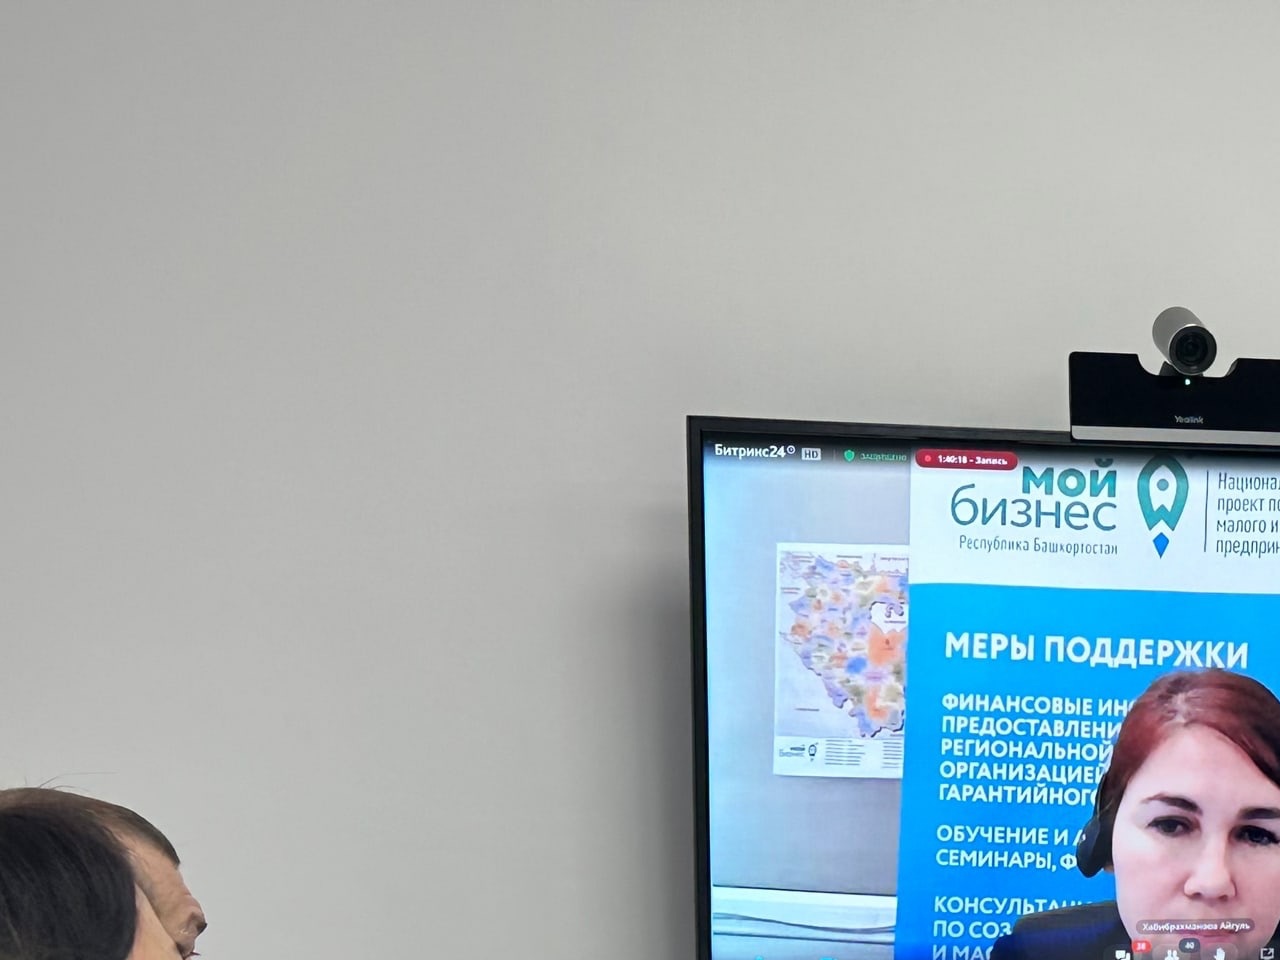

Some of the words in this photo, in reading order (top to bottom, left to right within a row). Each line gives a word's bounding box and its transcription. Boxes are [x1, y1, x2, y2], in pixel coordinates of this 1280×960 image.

[1174, 415, 1204, 424] Yealink
[715, 444, 786, 460] Битрикс24
[804, 449, 819, 459] HD
[975, 456, 1007, 466] Запись
[1022, 458, 1117, 498] мой
[951, 483, 1117, 532] бизнес
[1217, 497, 1265, 515] проект
[1216, 519, 1267, 534] малого
[1270, 520, 1279, 533] и
[959, 534, 1030, 554] Республика
[1033, 537, 1118, 557] Башкортостан
[945, 632, 1034, 661] МЕРЫ
[1045, 635, 1249, 669] ПОДДЕРЖКИ
[942, 693, 1092, 716] ФИНАНСОВЫЕ
[1098, 699, 1135, 717] ИН
[941, 738, 1114, 761] РЕГИОНАЛЬНОЙ
[936, 824, 1049, 845] ОБУЧЕНИЕ
[1054, 828, 1069, 846] И
[936, 849, 1056, 872] СЕМИНАРЫ,
[933, 920, 965, 938] ПО
[1219, 921, 1250, 932] Айгуль
